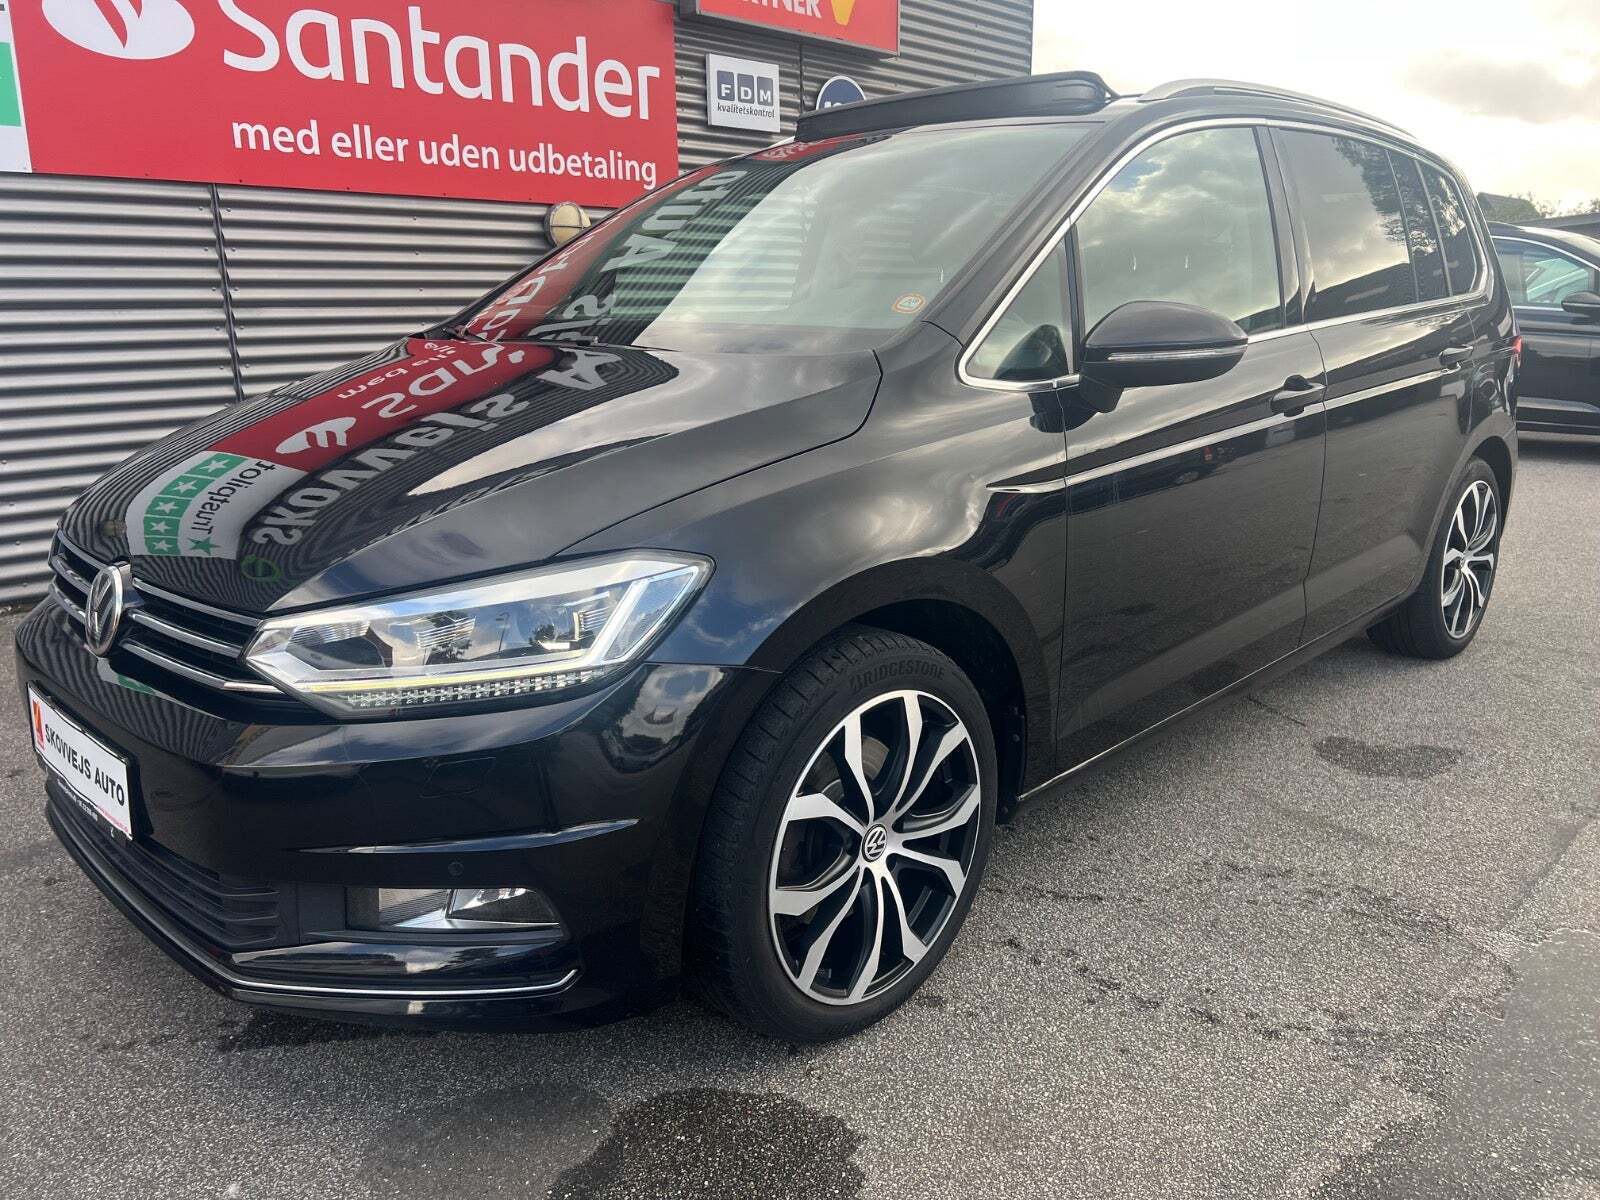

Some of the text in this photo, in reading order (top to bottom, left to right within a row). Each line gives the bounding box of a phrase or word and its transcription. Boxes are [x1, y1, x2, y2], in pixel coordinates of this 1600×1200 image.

[218, 0, 661, 121] Santander
[720, 83, 772, 103] FDM
[717, 102, 775, 118] kvalitetskontrol
[232, 119, 657, 190] med eller uden udbetaling
[44, 723, 92, 780] SKOVVEJS
[94, 767, 126, 807] AUTO
